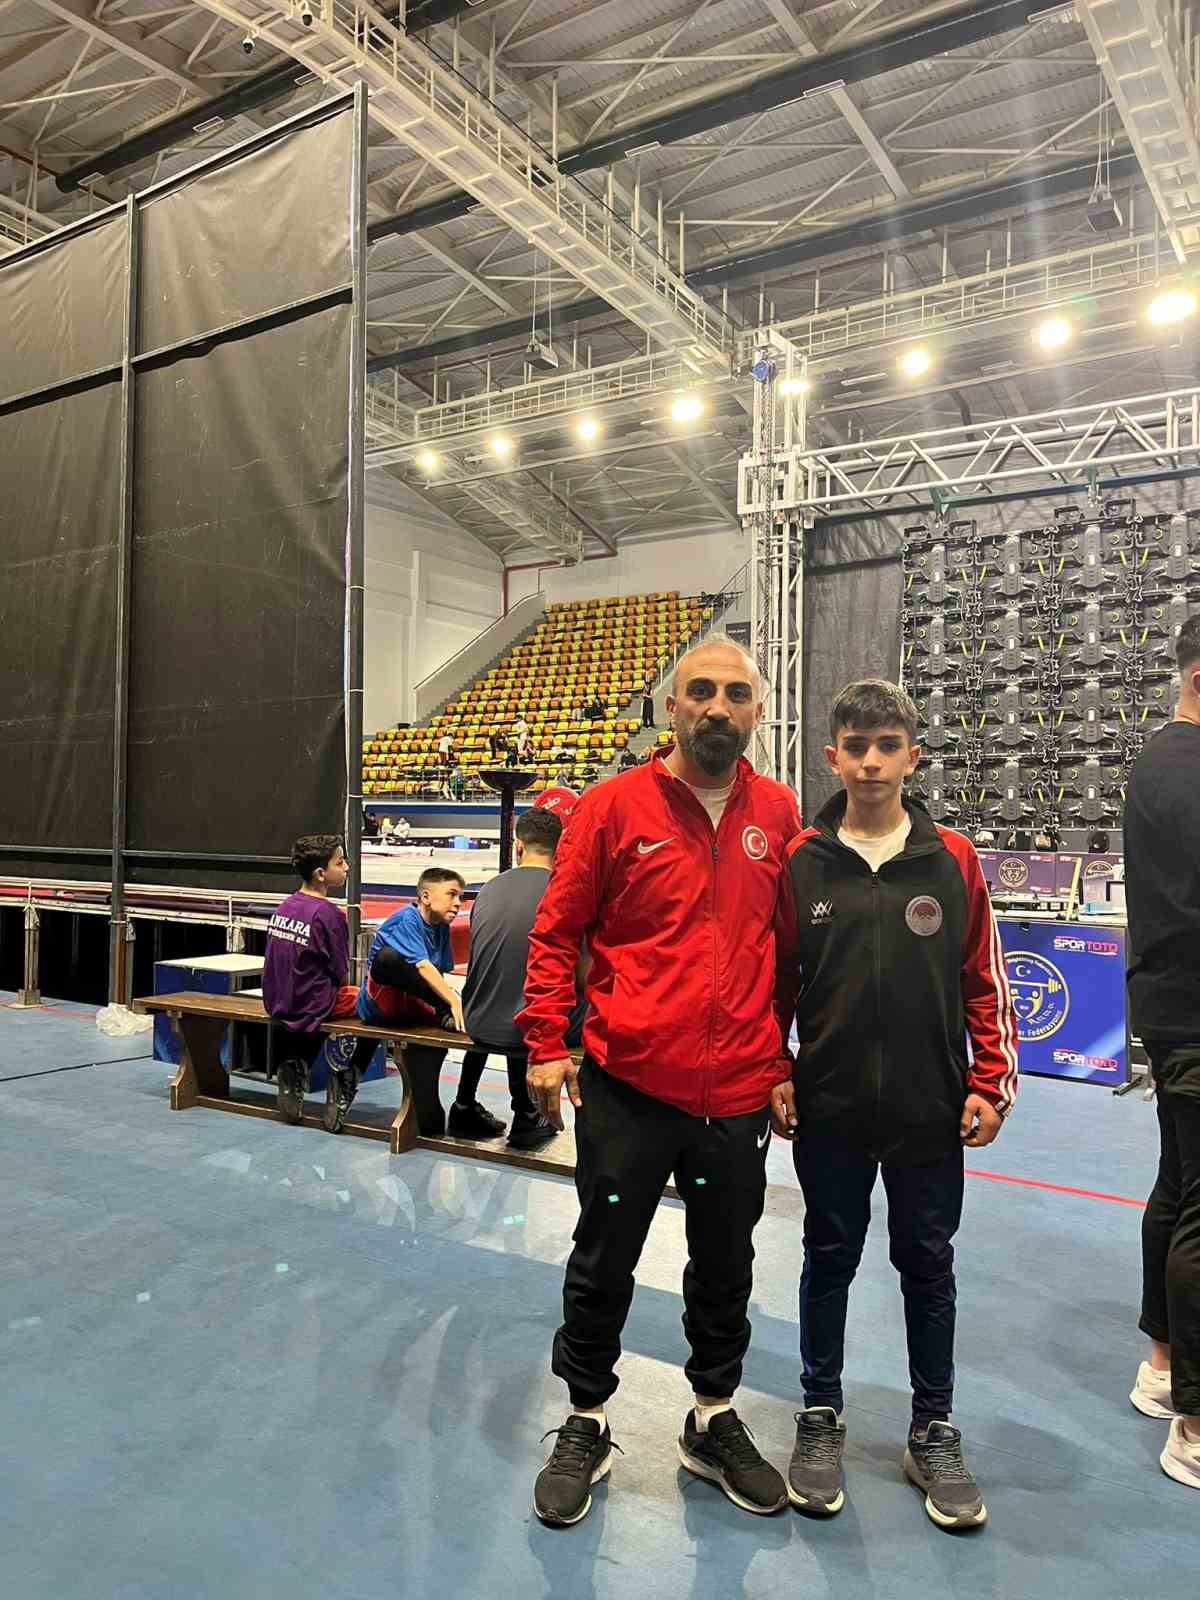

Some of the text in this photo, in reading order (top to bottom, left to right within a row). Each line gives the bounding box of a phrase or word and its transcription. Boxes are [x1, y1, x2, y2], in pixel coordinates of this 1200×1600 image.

[1053, 939, 1119, 953] SPOR TOTO
[1053, 1052, 1086, 1065] SPOR
